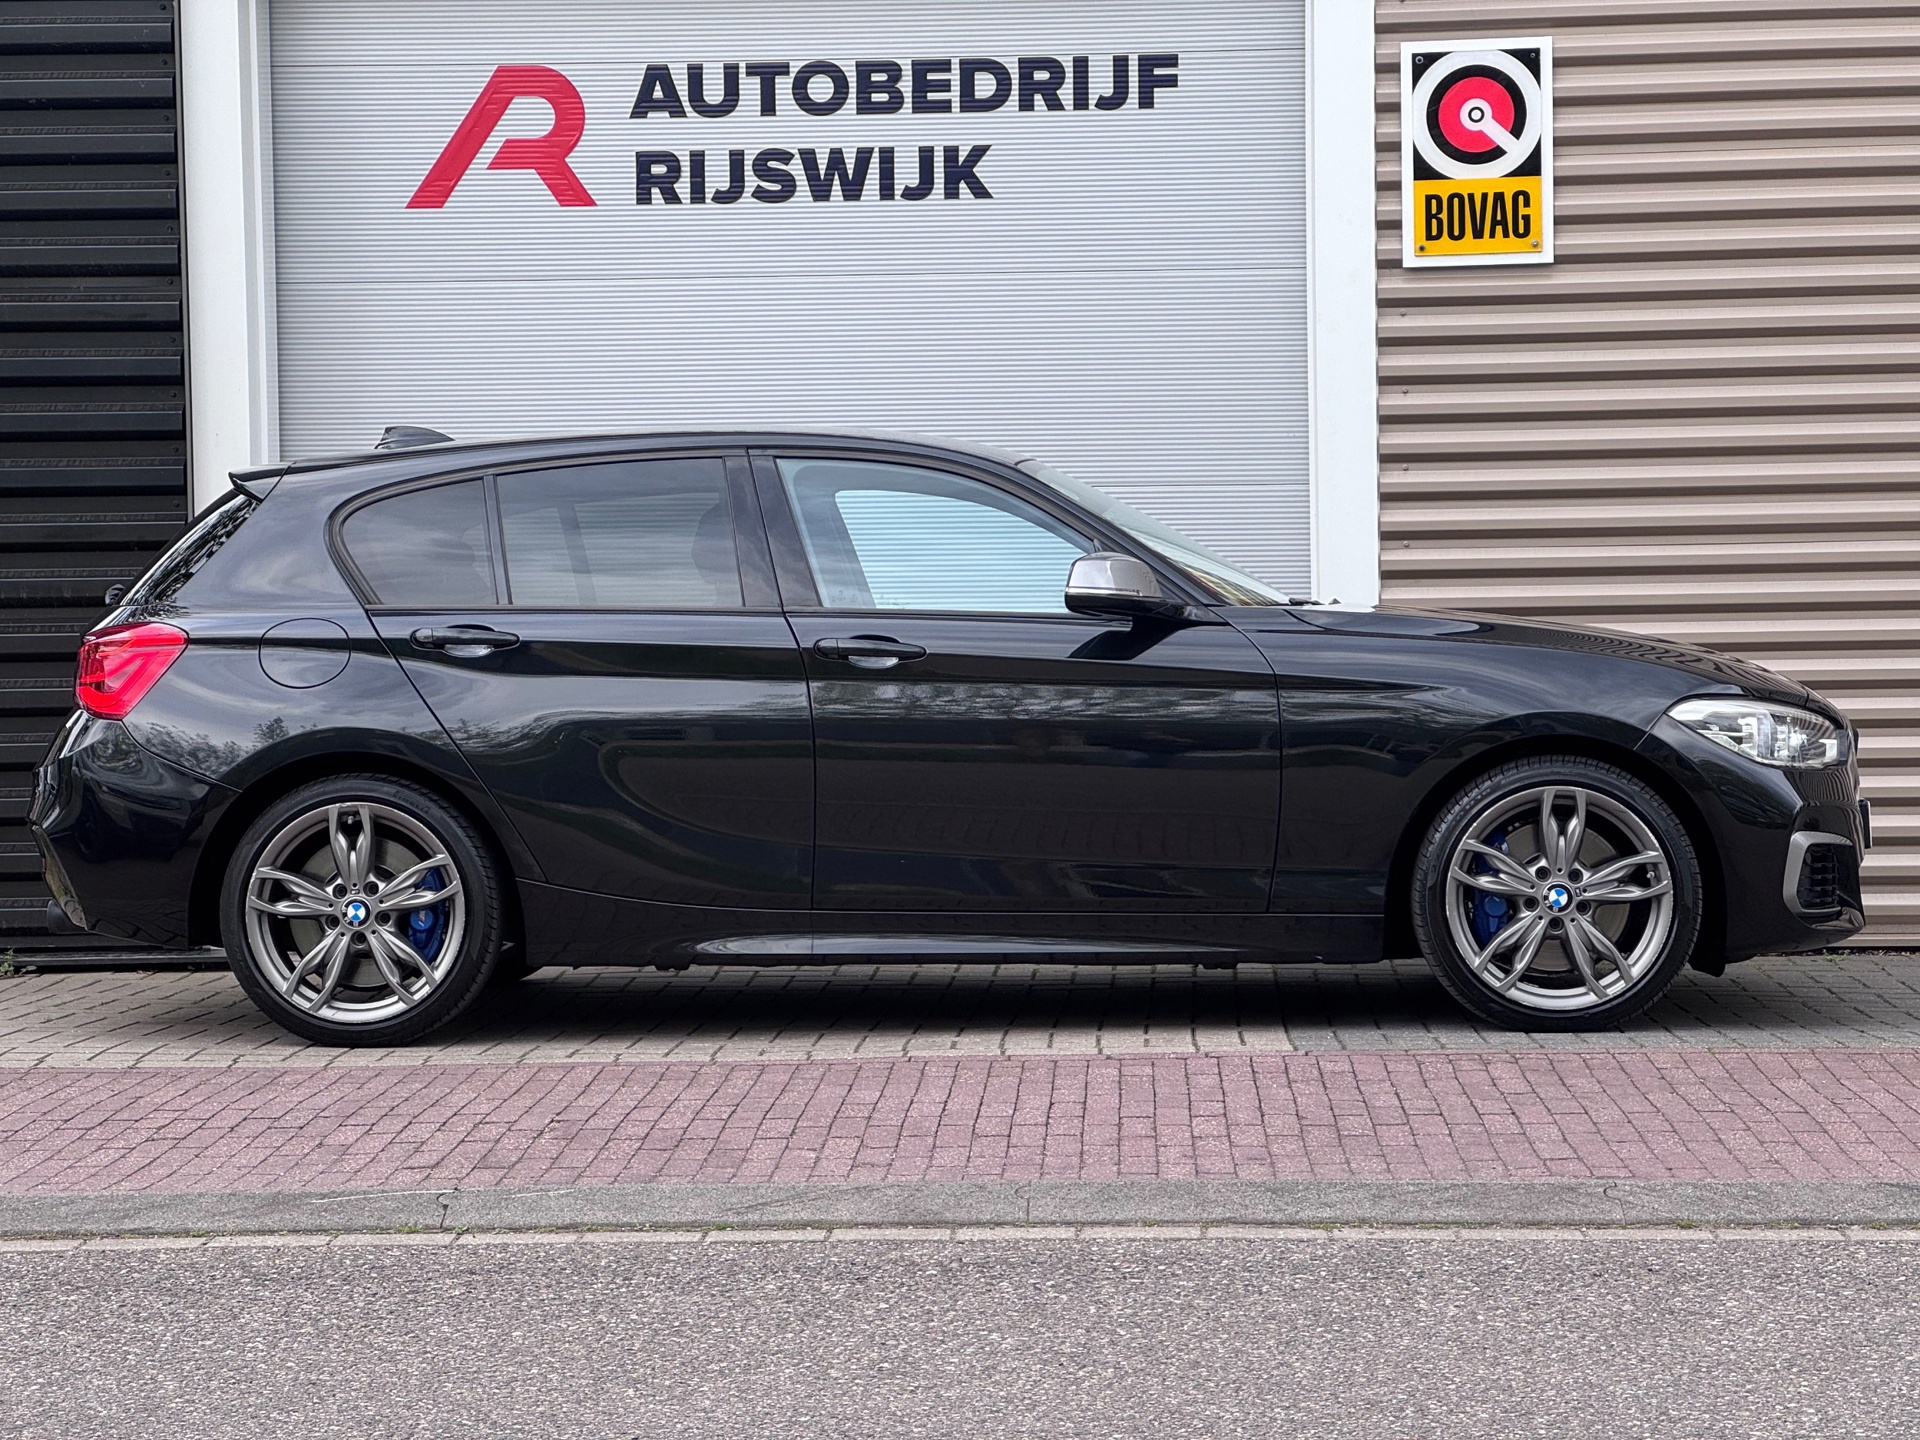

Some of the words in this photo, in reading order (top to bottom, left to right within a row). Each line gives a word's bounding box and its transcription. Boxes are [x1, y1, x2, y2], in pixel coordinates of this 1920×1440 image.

[629, 53, 1179, 119] AUTOBEDRIJF
[635, 144, 994, 206] RIJSWIJK
[1424, 190, 1532, 242] BOVAG
